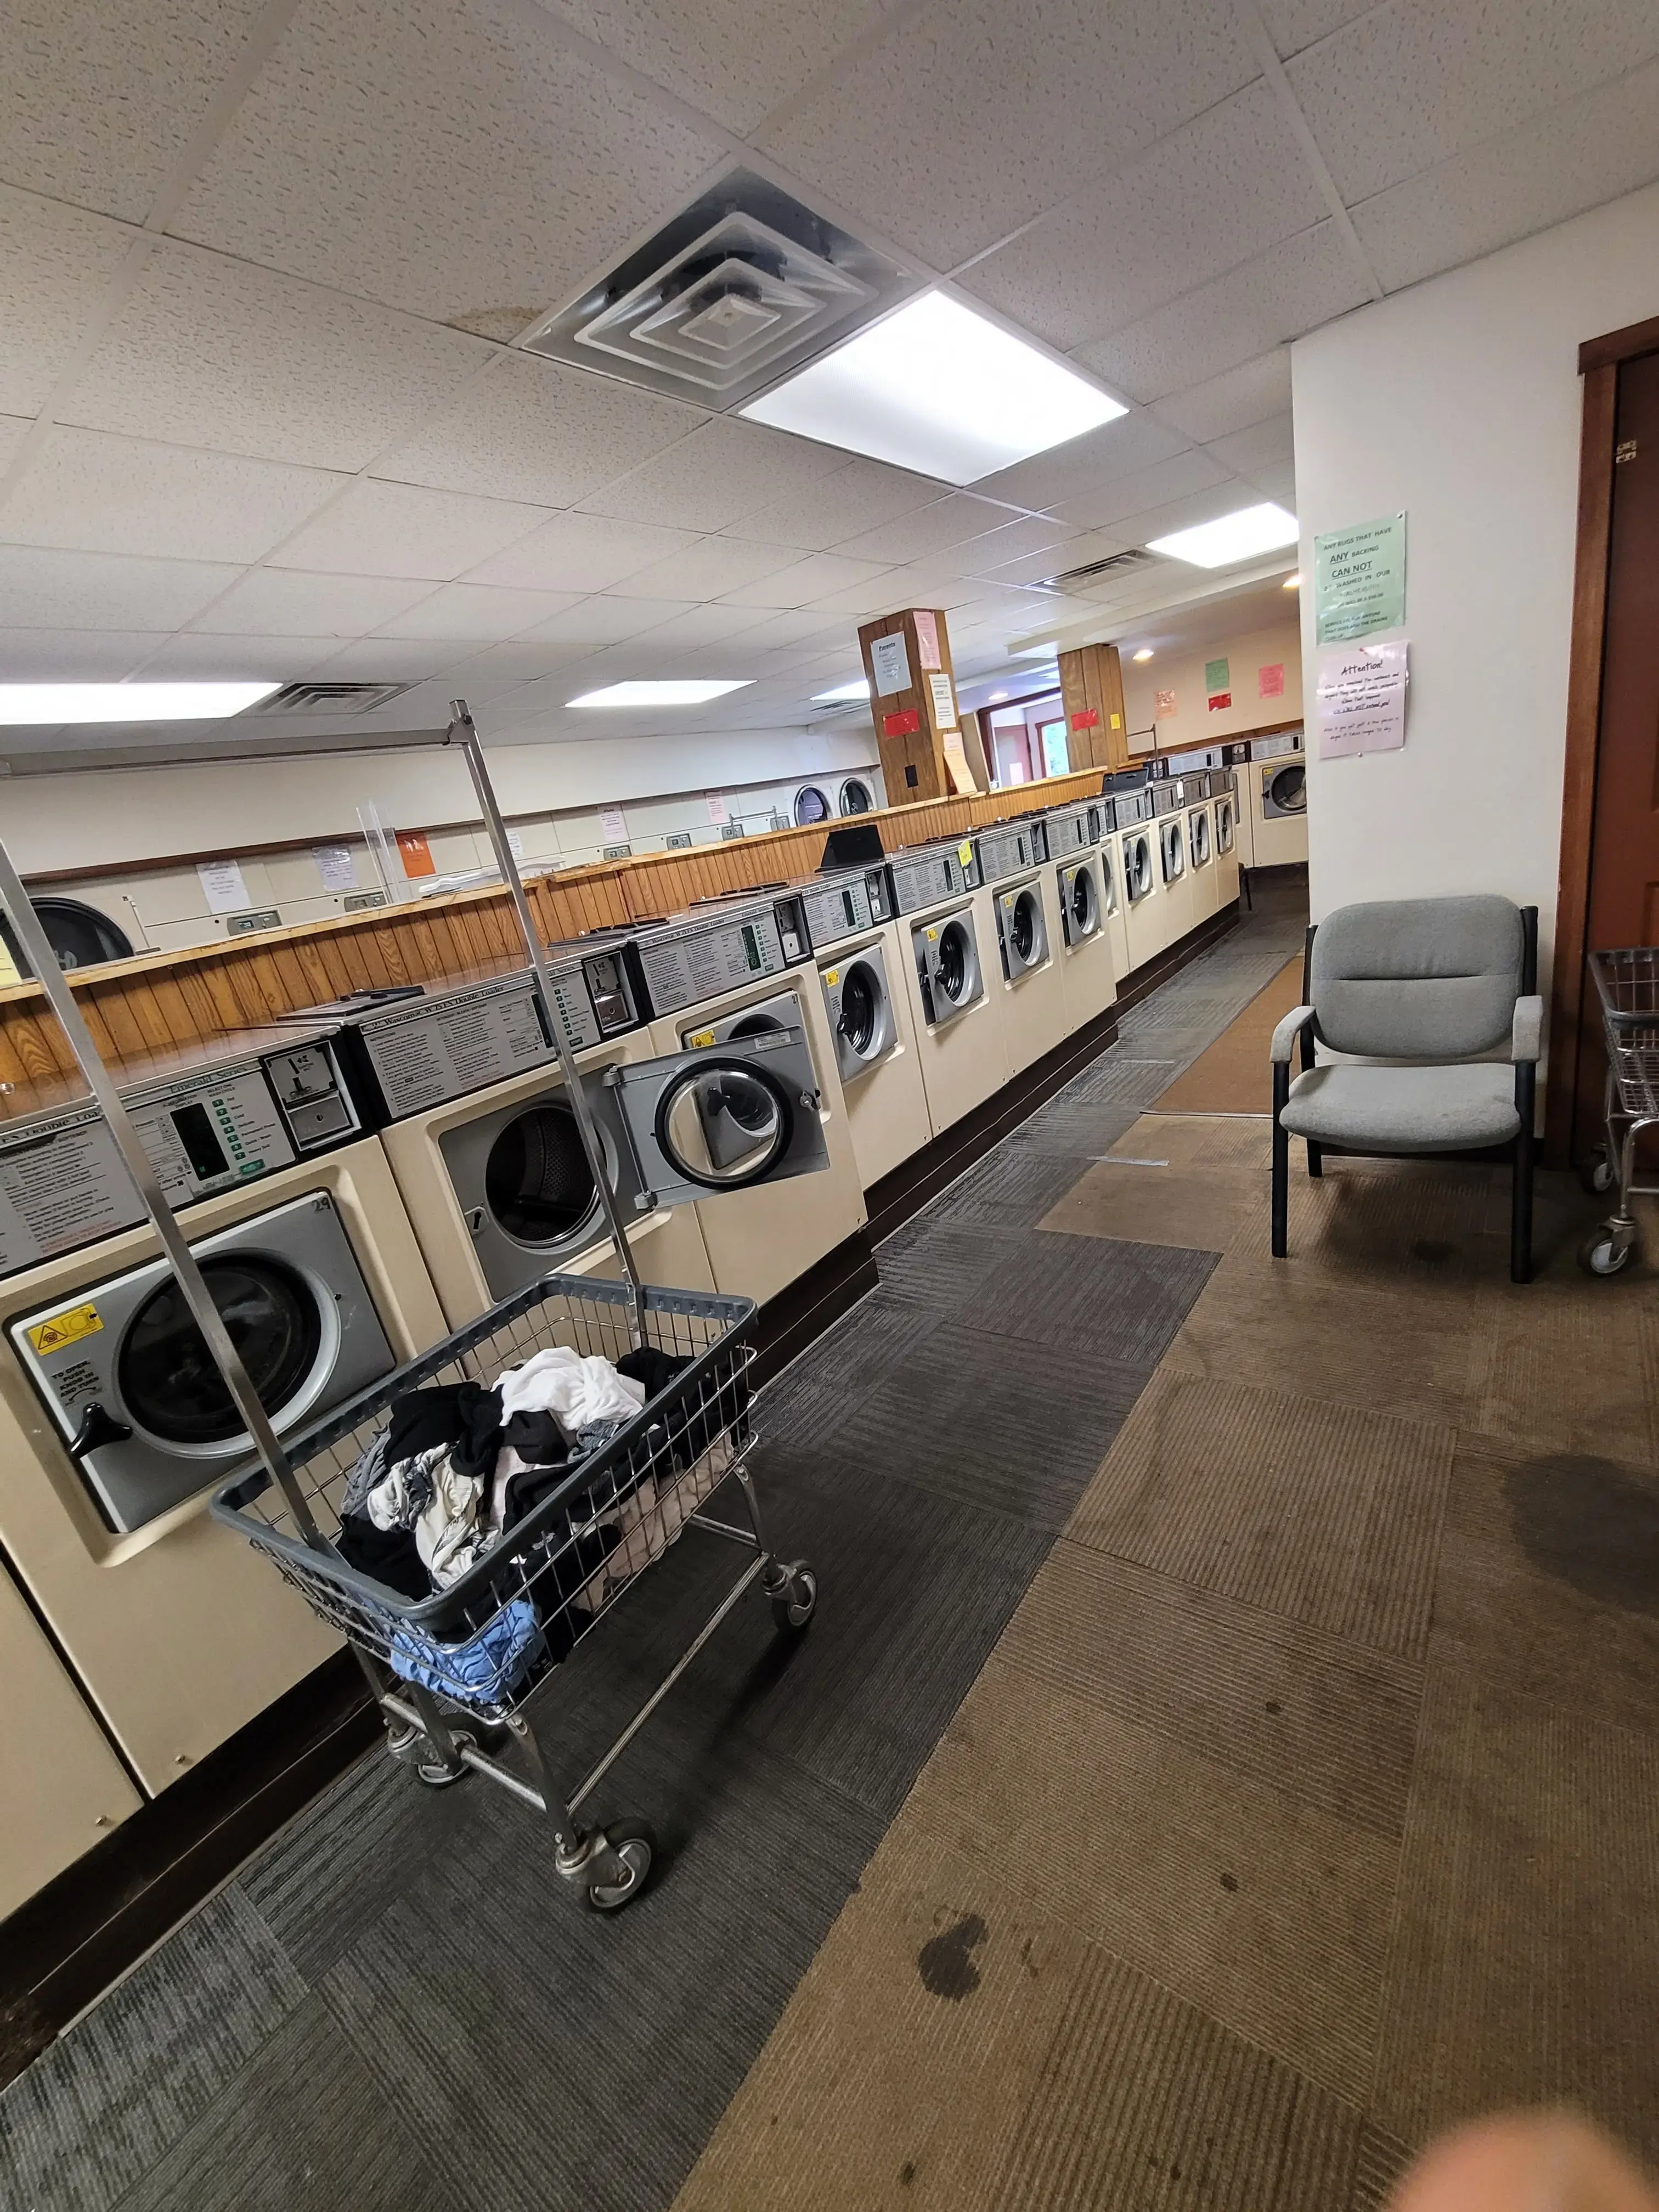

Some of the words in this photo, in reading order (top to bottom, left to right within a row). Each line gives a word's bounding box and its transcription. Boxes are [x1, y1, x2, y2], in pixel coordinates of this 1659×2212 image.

[1324, 542, 1336, 551] ANY
[1338, 537, 1354, 547] RUGS
[1356, 533, 1372, 542] THAT
[1374, 527, 1392, 537] HAVE
[1330, 551, 1349, 563] ANY
[1352, 545, 1379, 557] BACKING
[1331, 566, 1350, 578] CAN
[1353, 561, 1373, 573] NOT
[1336, 577, 1362, 588] WASHED
[1376, 569, 1390, 578] OUR
[1370, 616, 1388, 624] DRAINS
[878, 642, 896, 652] Parents
[384, 1011, 423, 1025] Wascomat
[455, 992, 479, 1005] Double
[481, 986, 505, 997] Loader
[170, 1076, 213, 1094] Emerald
[217, 1068, 247, 1079] Series
[221, 1086, 235, 1094] CYCLE
[77, 1111, 100, 1122] Loa
[52, 1371, 64, 1379] TO
[59, 1377, 83, 1390] KNOB
[84, 1371, 94, 1380] IN
[63, 1368, 86, 1383] PUSH
[60, 1387, 77, 1398] AND
[78, 1376, 100, 1387] TURN
